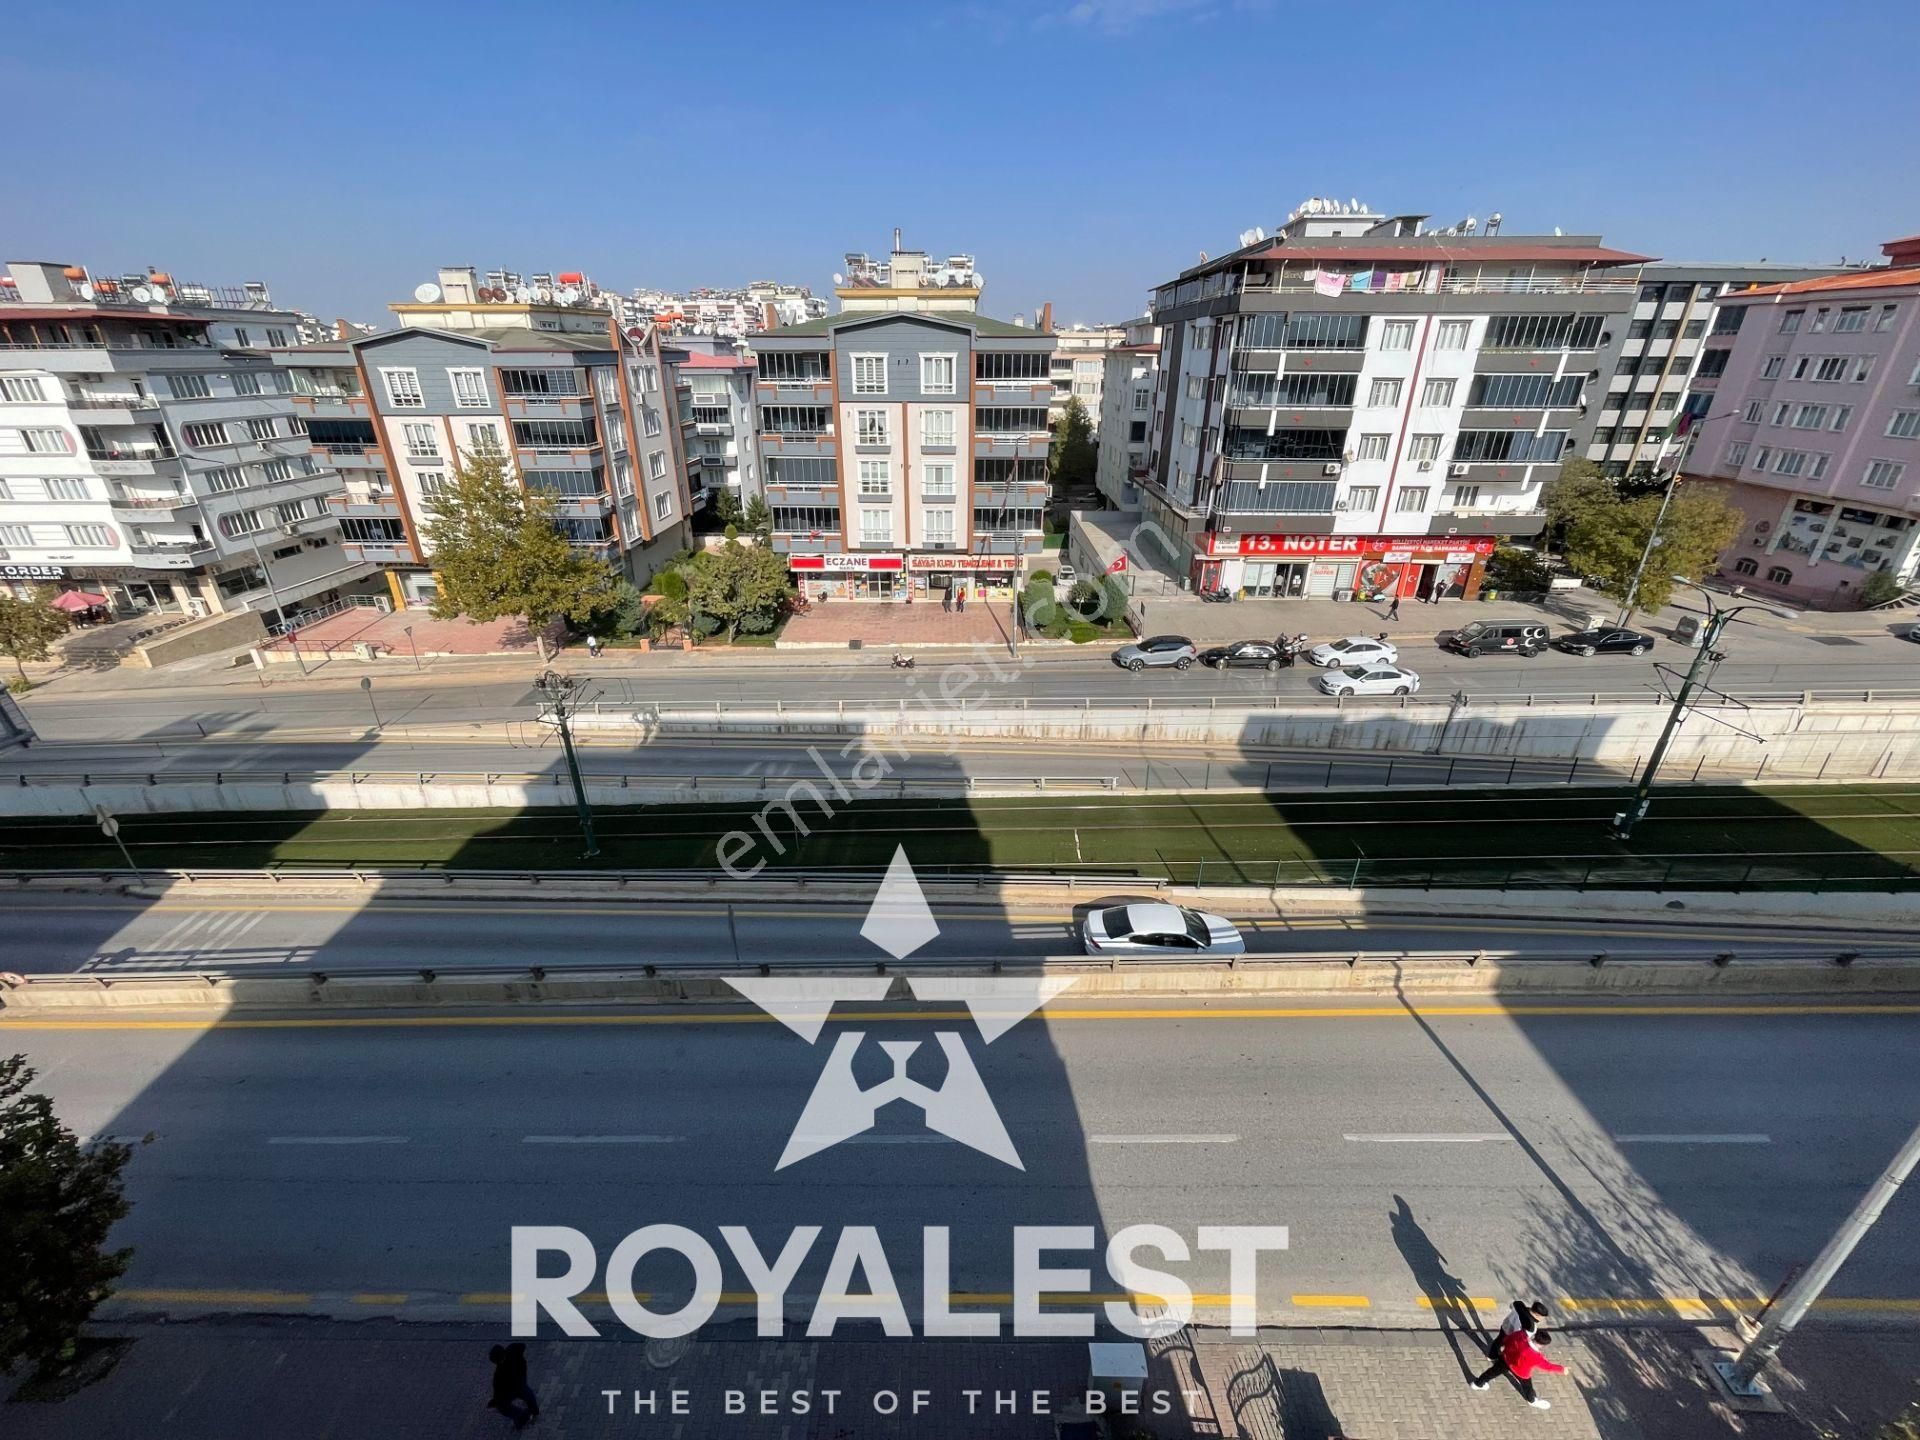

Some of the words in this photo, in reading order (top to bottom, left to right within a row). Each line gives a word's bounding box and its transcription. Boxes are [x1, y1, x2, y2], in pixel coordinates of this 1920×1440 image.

[1246, 535, 1276, 551] 13.
[1283, 535, 1358, 551] NOTER
[826, 557, 868, 566] ECZANE
[912, 559, 936, 568] SAYAR
[936, 559, 956, 568] KURU
